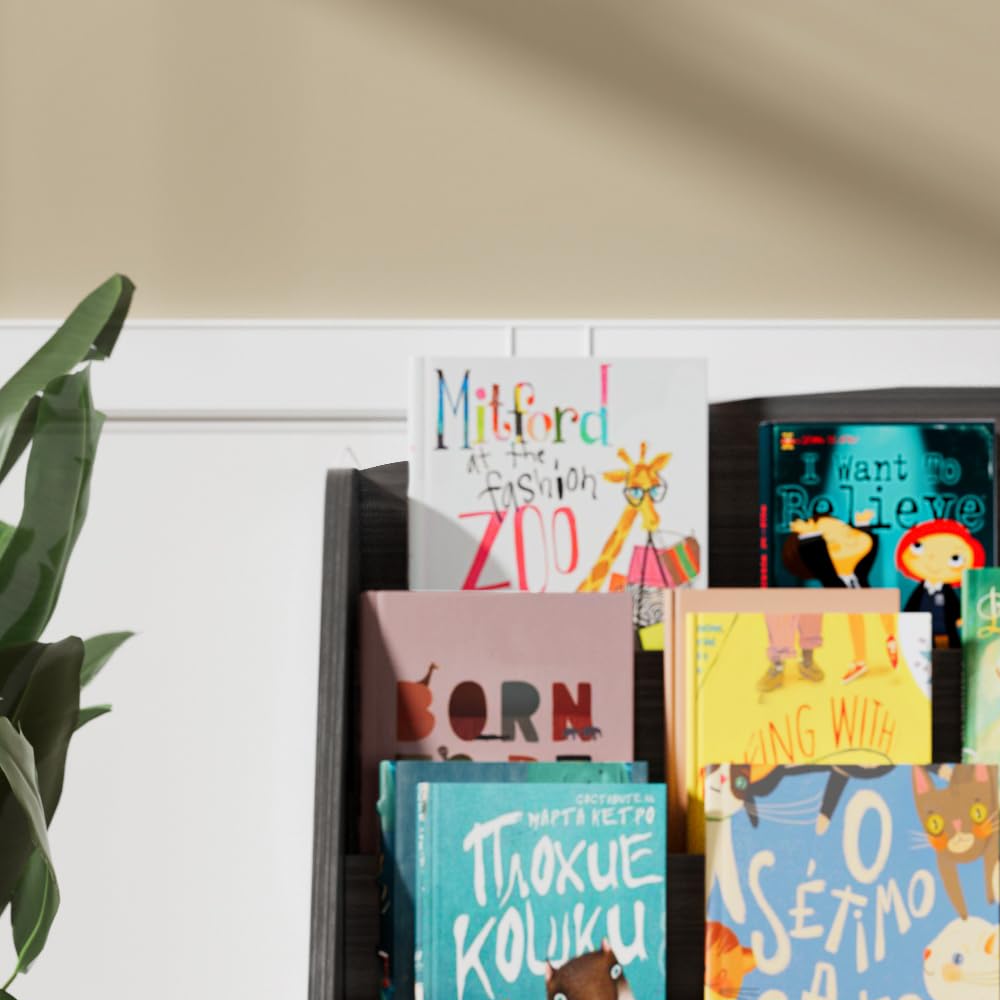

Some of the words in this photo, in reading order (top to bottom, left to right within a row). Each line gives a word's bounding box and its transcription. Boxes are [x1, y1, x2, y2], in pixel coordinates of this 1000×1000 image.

[434, 363, 614, 450] Mitford
[467, 451, 493, 474] at
[506, 443, 547, 467] the
[801, 452, 820, 485] I
[836, 452, 908, 484] Want
[477, 458, 599, 524] fashion
[775, 483, 987, 532] Believe
[457, 504, 579, 592] ZOO
[396, 680, 592, 742] BORN
[830, 695, 897, 754] WITH
[527, 808, 587, 829] МАРТА
[592, 805, 657, 827] КЕТРО
[842, 788, 893, 885] O
